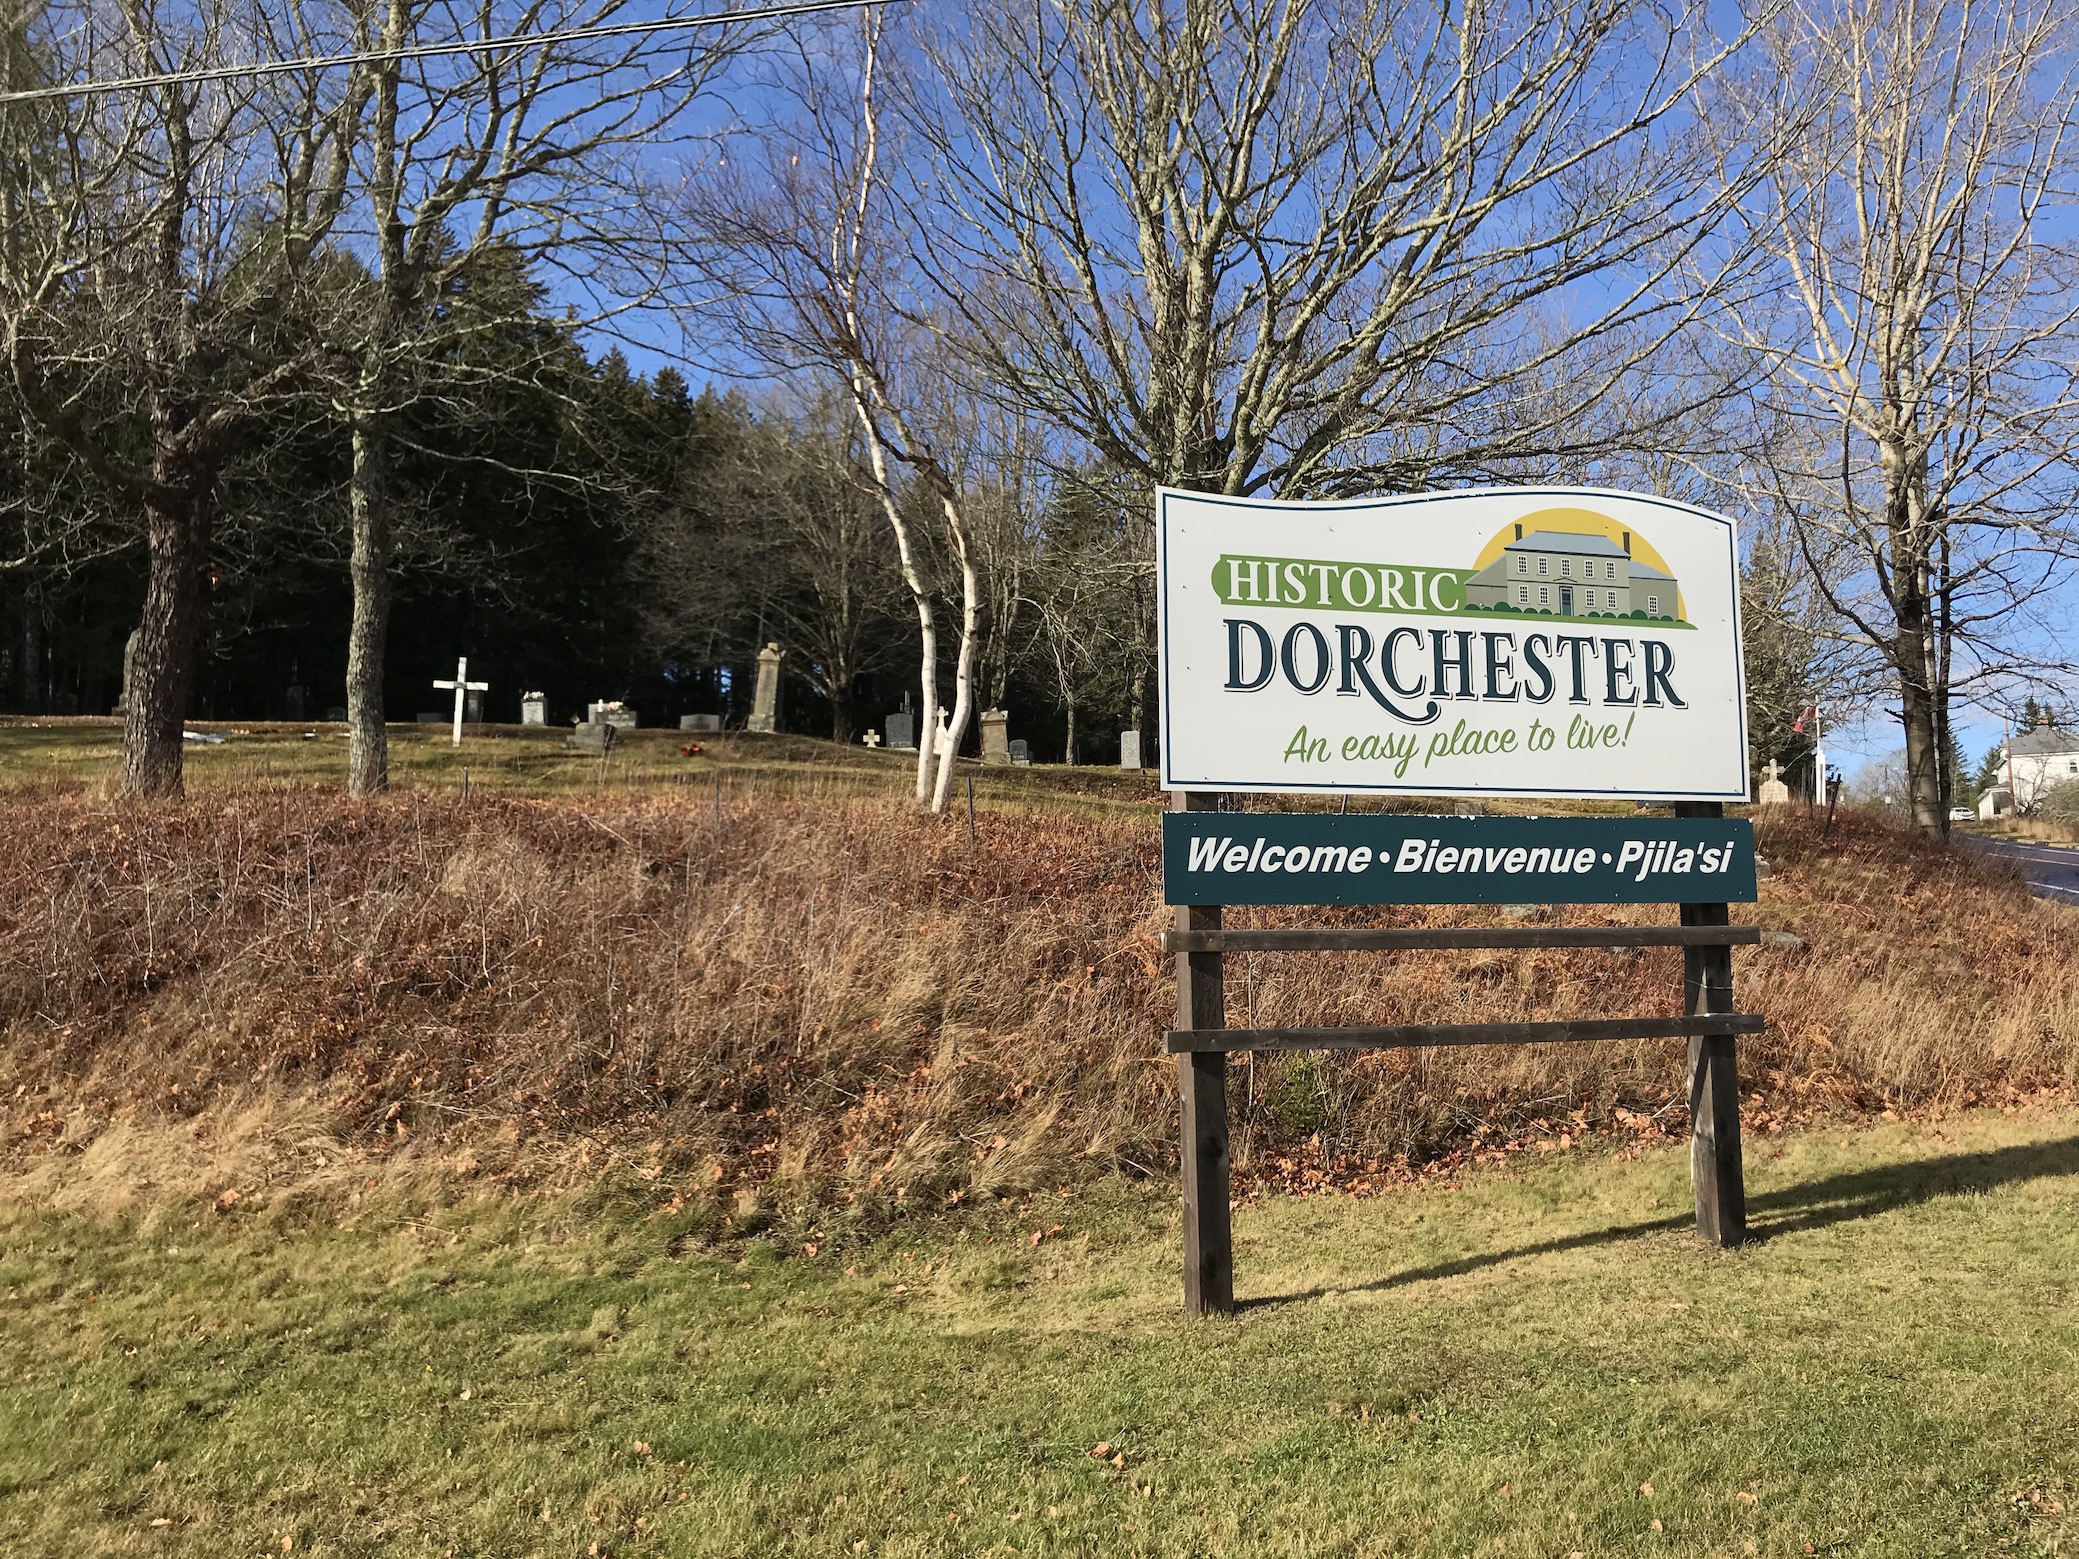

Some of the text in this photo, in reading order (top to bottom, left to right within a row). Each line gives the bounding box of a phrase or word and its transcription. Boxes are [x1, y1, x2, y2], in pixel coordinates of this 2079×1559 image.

[1228, 560, 1459, 612] HISTORIC
[1223, 619, 1689, 724] DORCHESTER
[1284, 711, 1635, 779] An easy place to live!
[1187, 837, 1734, 882] Welcome Bienvenue Pjila'si
